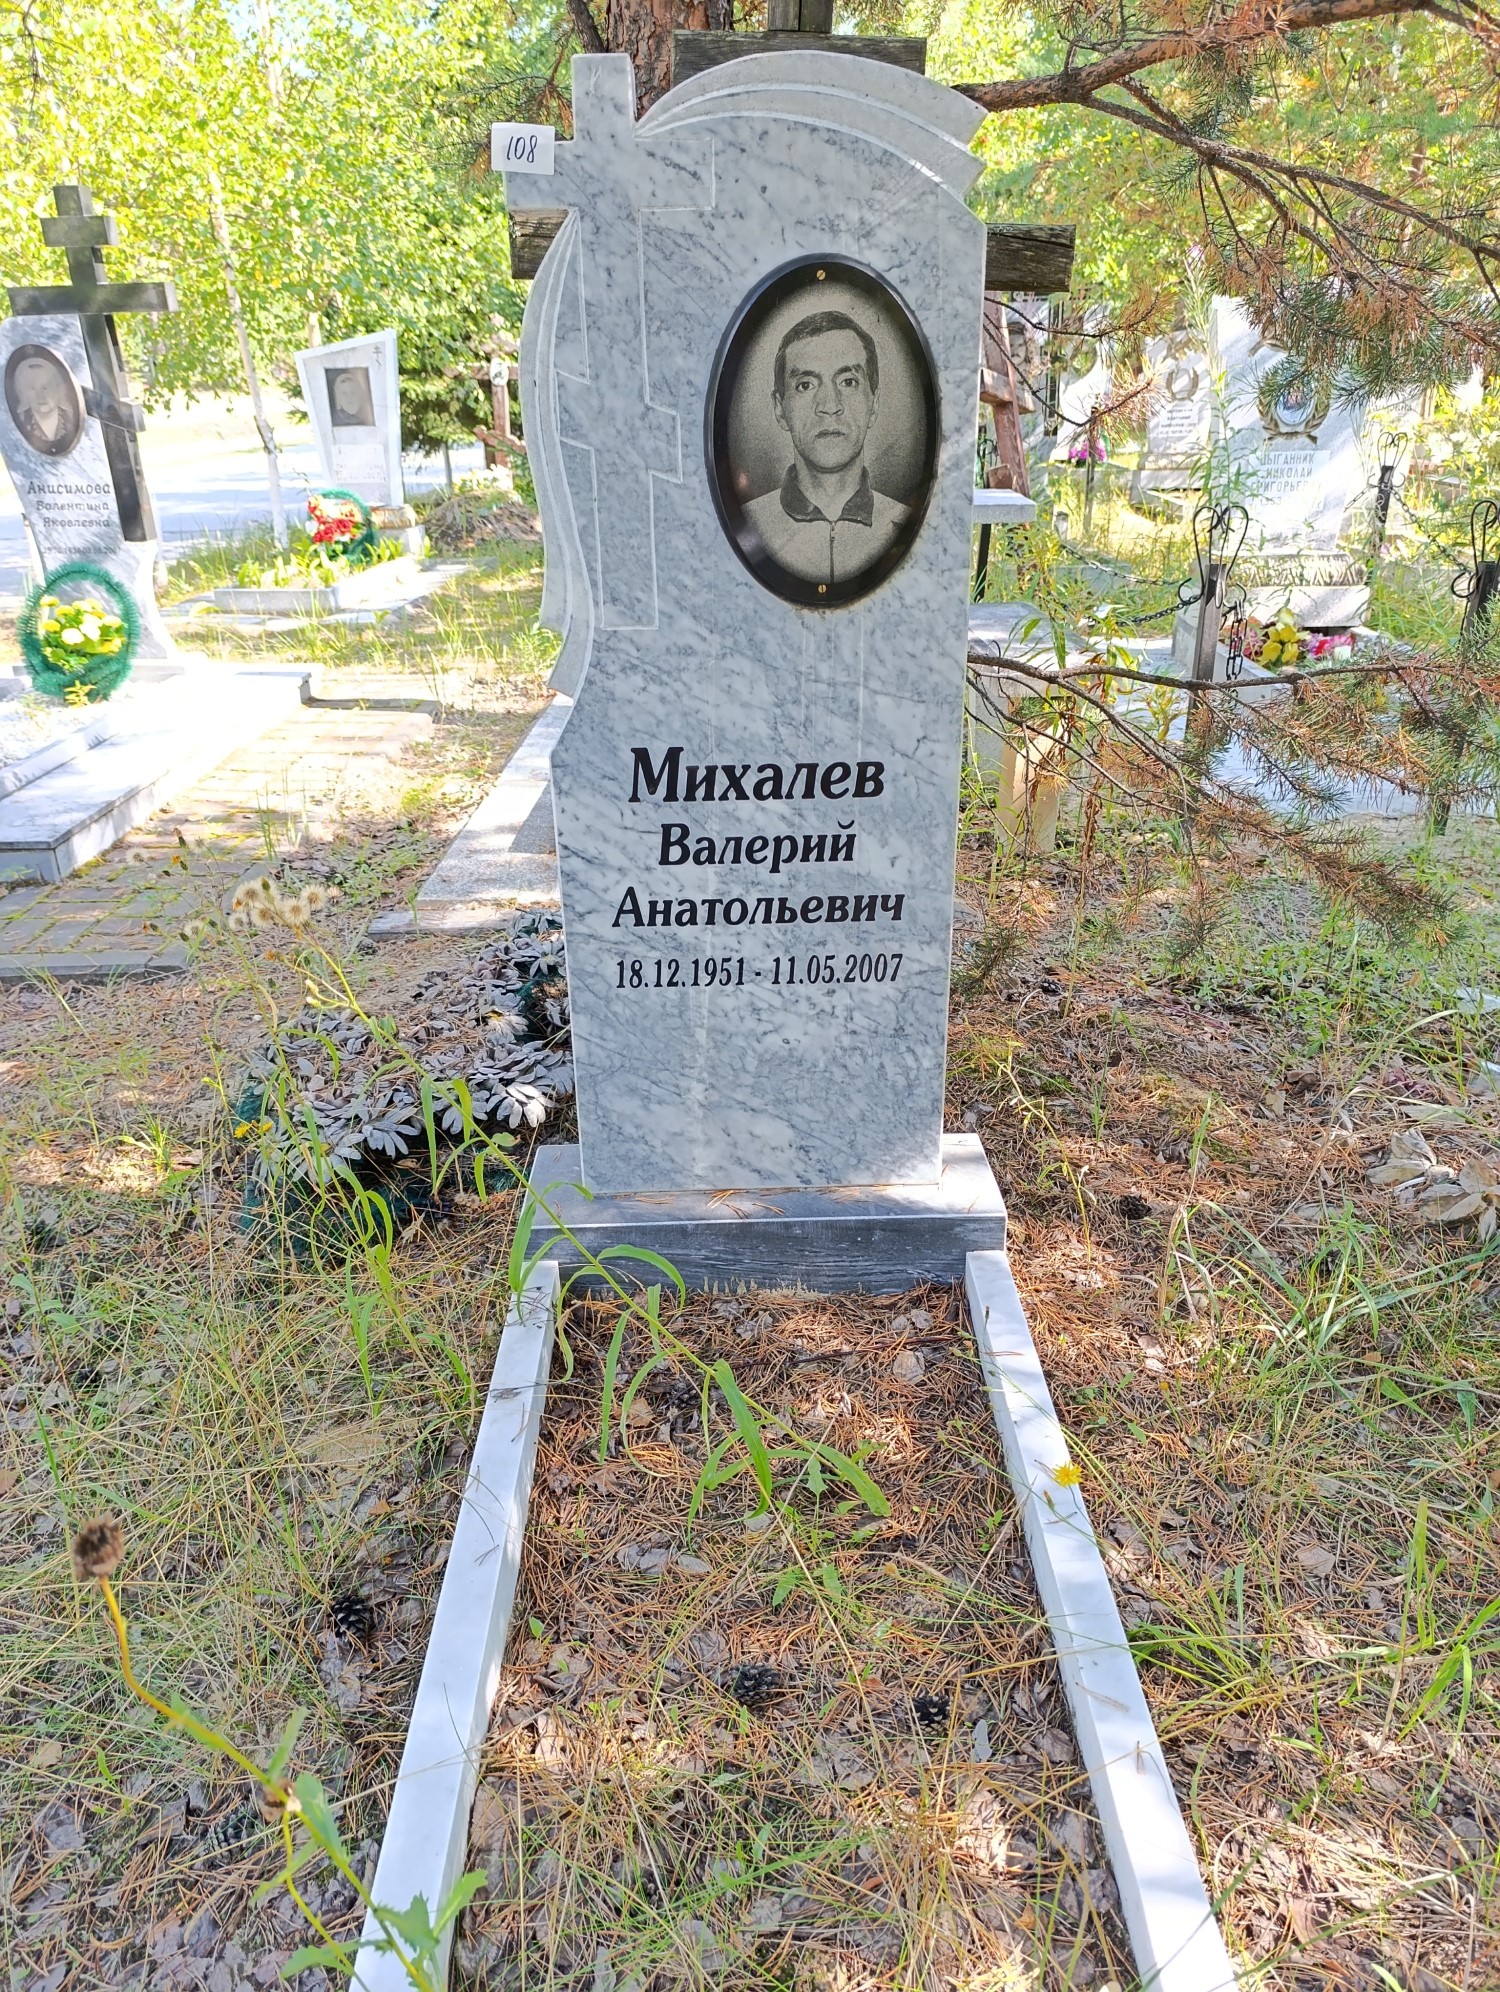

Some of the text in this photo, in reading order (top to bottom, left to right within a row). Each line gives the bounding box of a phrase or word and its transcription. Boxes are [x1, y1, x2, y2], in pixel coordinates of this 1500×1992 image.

[506, 134, 538, 164] 108
[27, 480, 112, 495] Анисимова
[36, 499, 110, 512] Валентина
[43, 516, 111, 528] Яковлевна
[627, 746, 886, 803] Михалев
[658, 819, 857, 874] Валерий
[611, 886, 906, 928] Анатольевич
[615, 957, 745, 989] 18.12.1951
[771, 952, 904, 985] 11.05.2007
